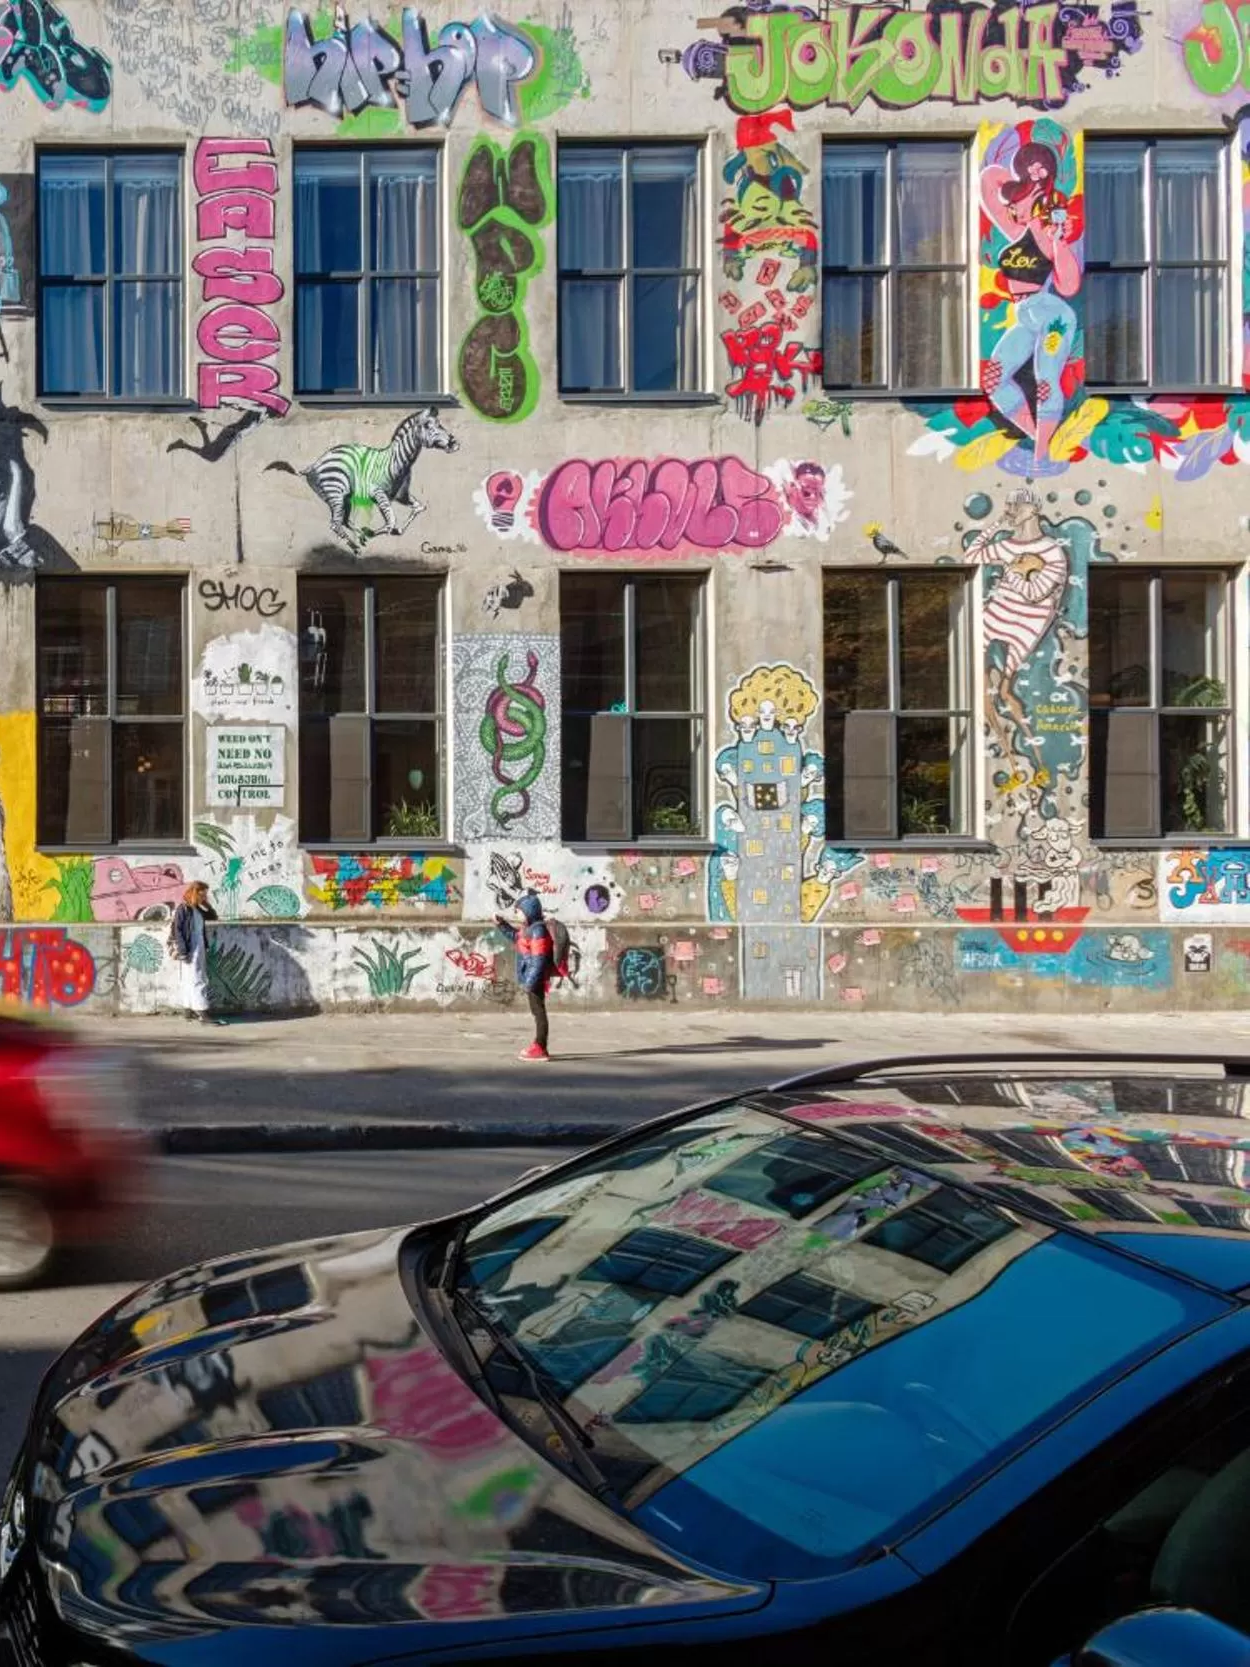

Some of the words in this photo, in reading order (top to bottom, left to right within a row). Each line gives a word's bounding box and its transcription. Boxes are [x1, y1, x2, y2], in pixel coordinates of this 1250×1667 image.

[218, 748, 251, 759] NEED
[254, 748, 272, 759] NO
[217, 790, 271, 799] CONTROL
